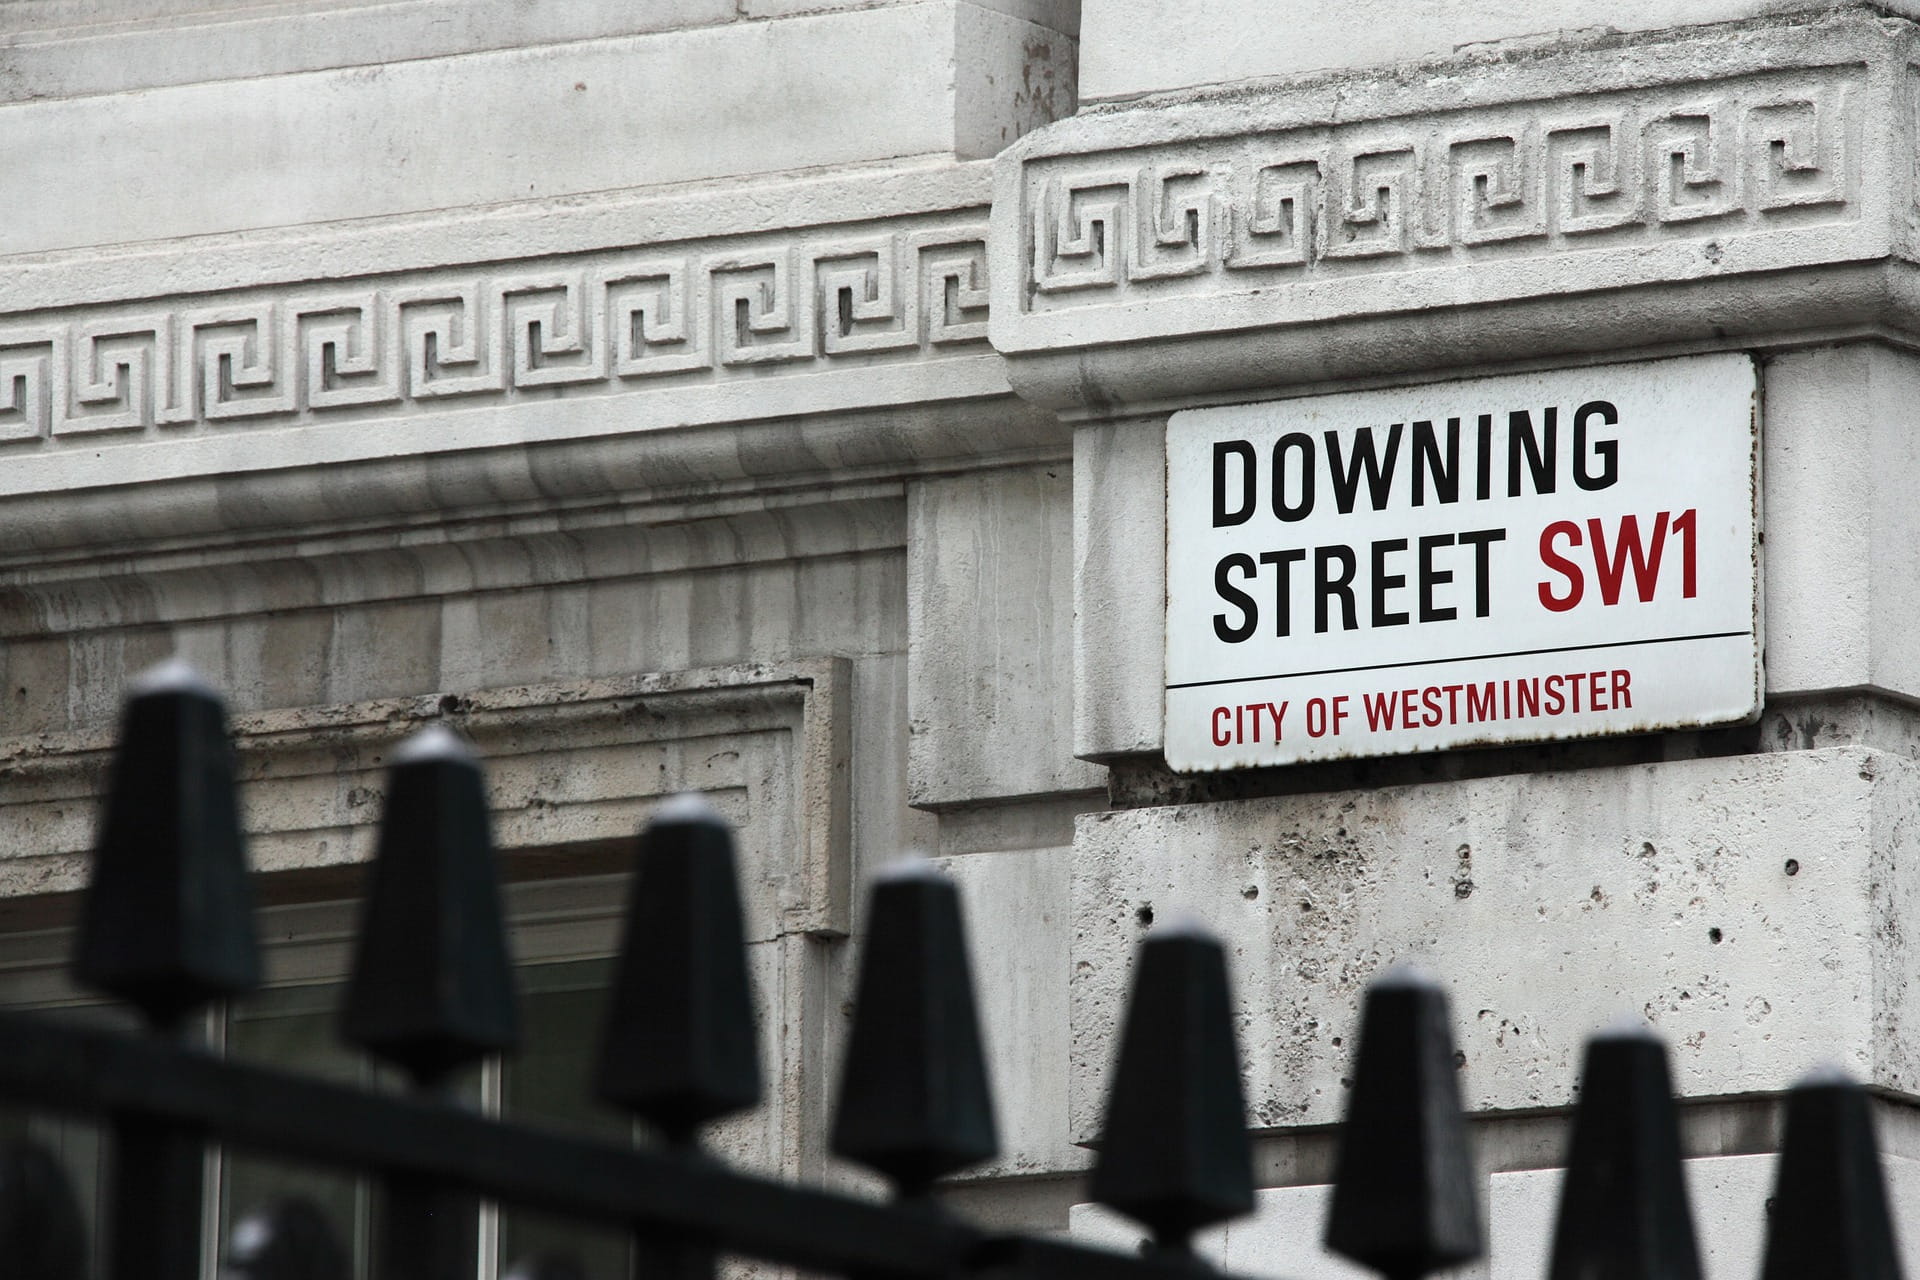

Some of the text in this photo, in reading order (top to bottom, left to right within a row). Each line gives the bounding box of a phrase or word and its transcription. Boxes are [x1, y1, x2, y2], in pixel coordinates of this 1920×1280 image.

[1212, 400, 1619, 528] DOWNING
[1213, 508, 1697, 643] STREET SW1
[1212, 669, 1633, 747] CITY OF WESTMINSTER
